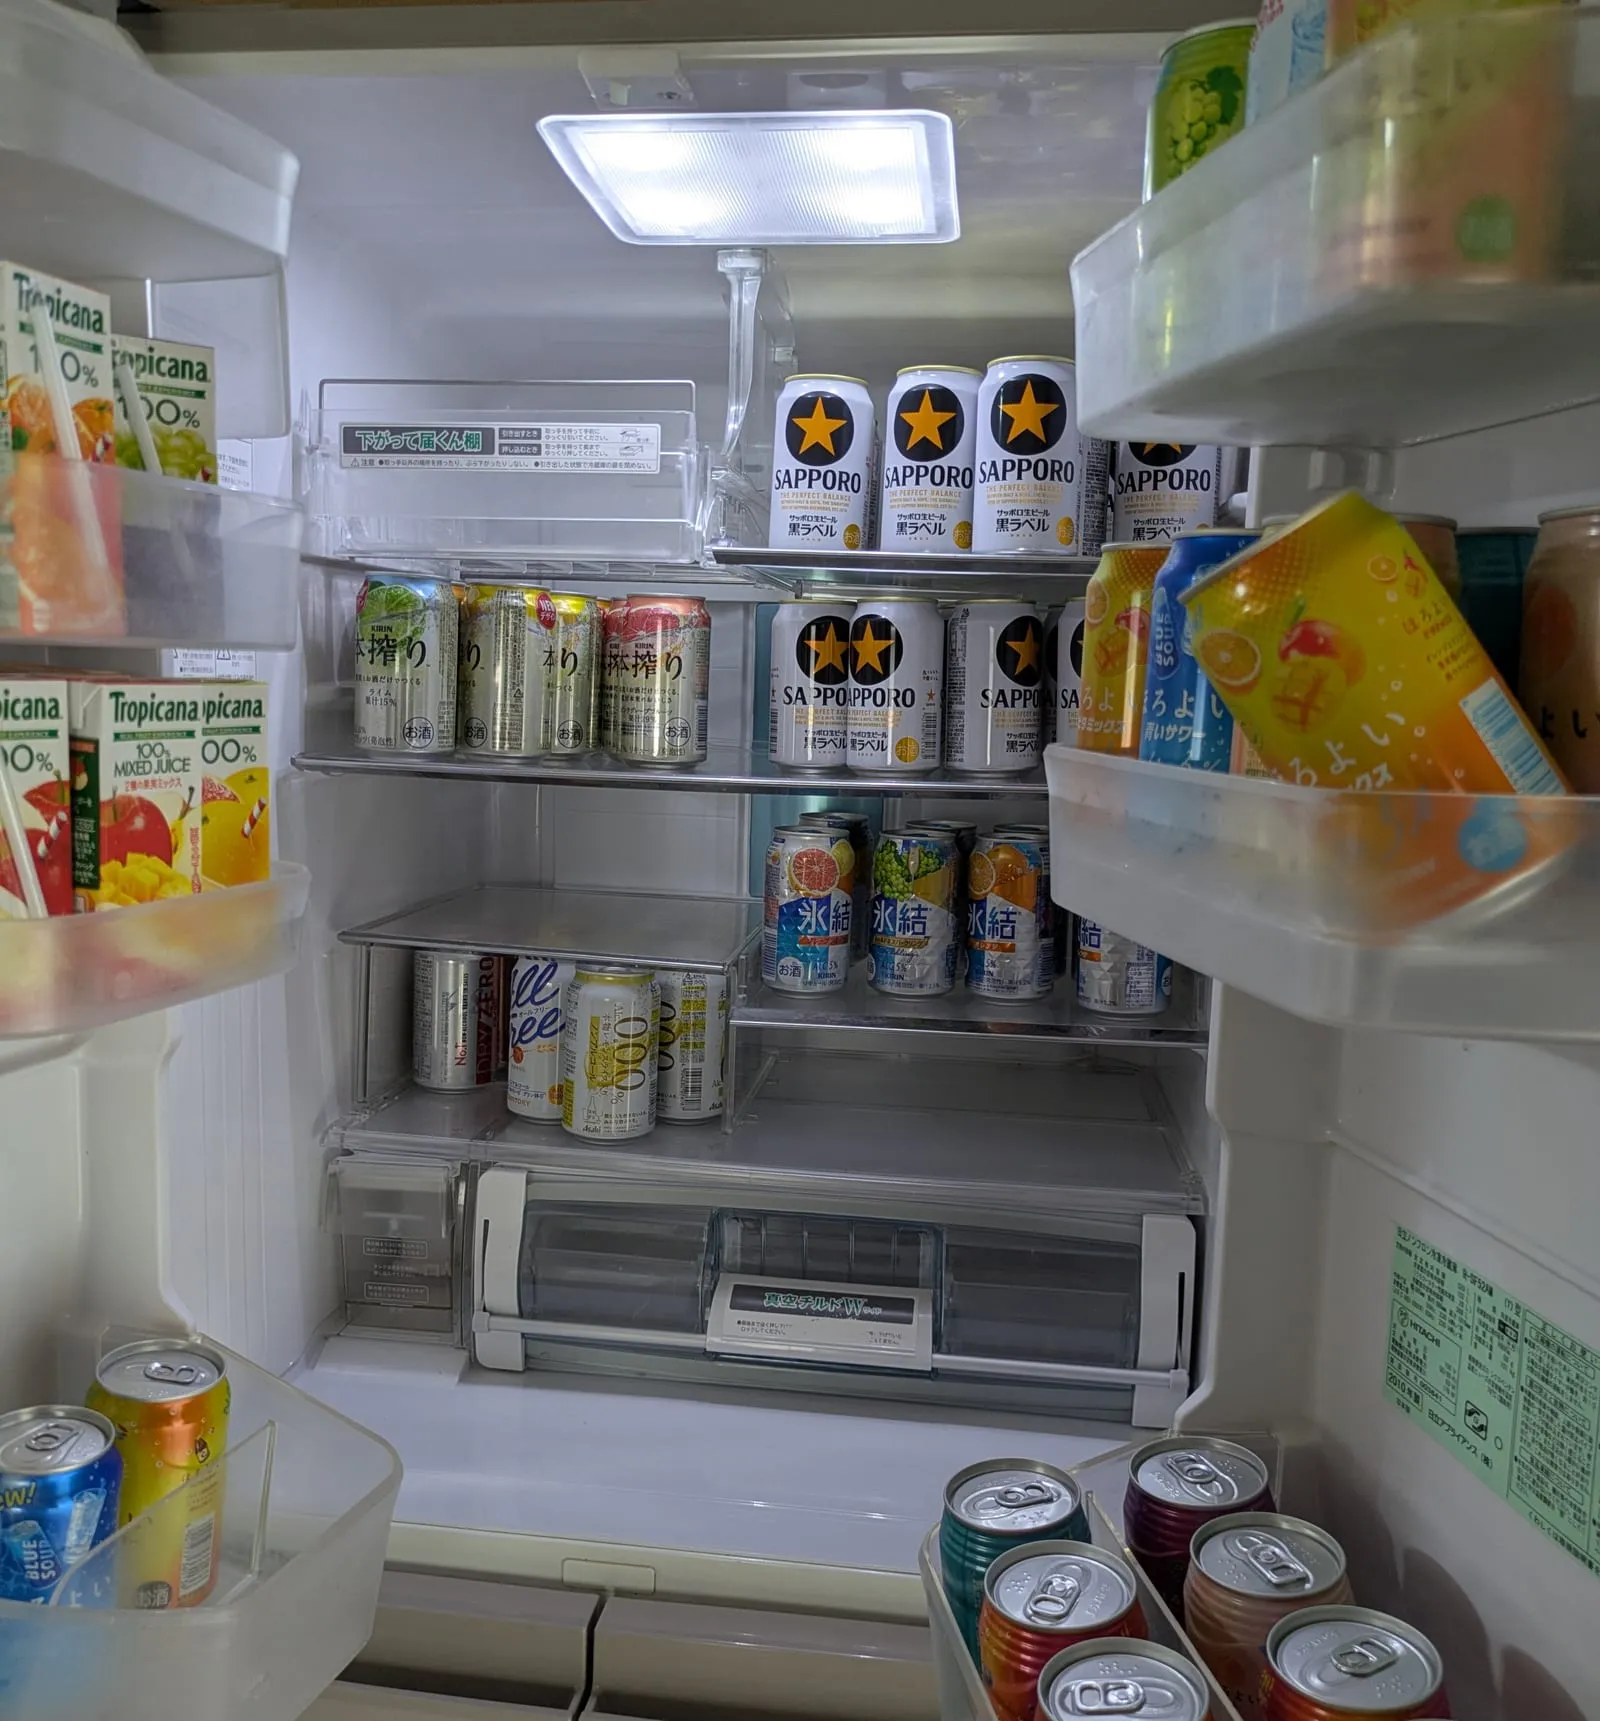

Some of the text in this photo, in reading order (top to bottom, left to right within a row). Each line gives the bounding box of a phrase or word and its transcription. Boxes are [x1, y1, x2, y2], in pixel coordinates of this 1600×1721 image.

[355, 429, 483, 452] 下がって届くん棚
[884, 464, 974, 489] SAPPORO
[978, 458, 1074, 484] SAPPORO
[774, 468, 861, 494] SAPPORO
[1117, 468, 1211, 496] SAPPORO
[789, 514, 838, 524] サッポロ生ビール
[896, 513, 947, 522] サッポロ生ビール
[996, 508, 1051, 517] サッポロ生ビール
[788, 522, 838, 538] 黒ラベル
[895, 521, 947, 536] 黒ラベル
[995, 518, 1050, 532] 黒ラベル
[1133, 518, 1186, 526] サッポロ生ビール
[1132, 527, 1182, 542] 黒ラベ
[371, 625, 393, 634] KIRIN
[369, 688, 392, 697] ライム
[0, 688, 63, 720] icana
[110, 691, 200, 728] Tropicana
[405, 726, 432, 741] お酒
[465, 726, 485, 739] お酒
[559, 729, 581, 741] お酒
[665, 726, 689, 739] お酒
[1144, 722, 1206, 742] 青いサワー
[114, 757, 192, 778] MIXED JUICE
[800, 900, 851, 934] 氷結
[873, 899, 928, 936] 氷結
[968, 904, 1018, 940] 氷結
[778, 964, 801, 978] お酒
[518, 1006, 551, 1019] オールフリー
[455, 1042, 467, 1067] No.1
[589, 1023, 599, 1082] ノンアルコール
[582, 1125, 602, 1134] Asahi
[1410, 1319, 1440, 1348] HITACHI
[22, 1539, 40, 1580] BLUE
